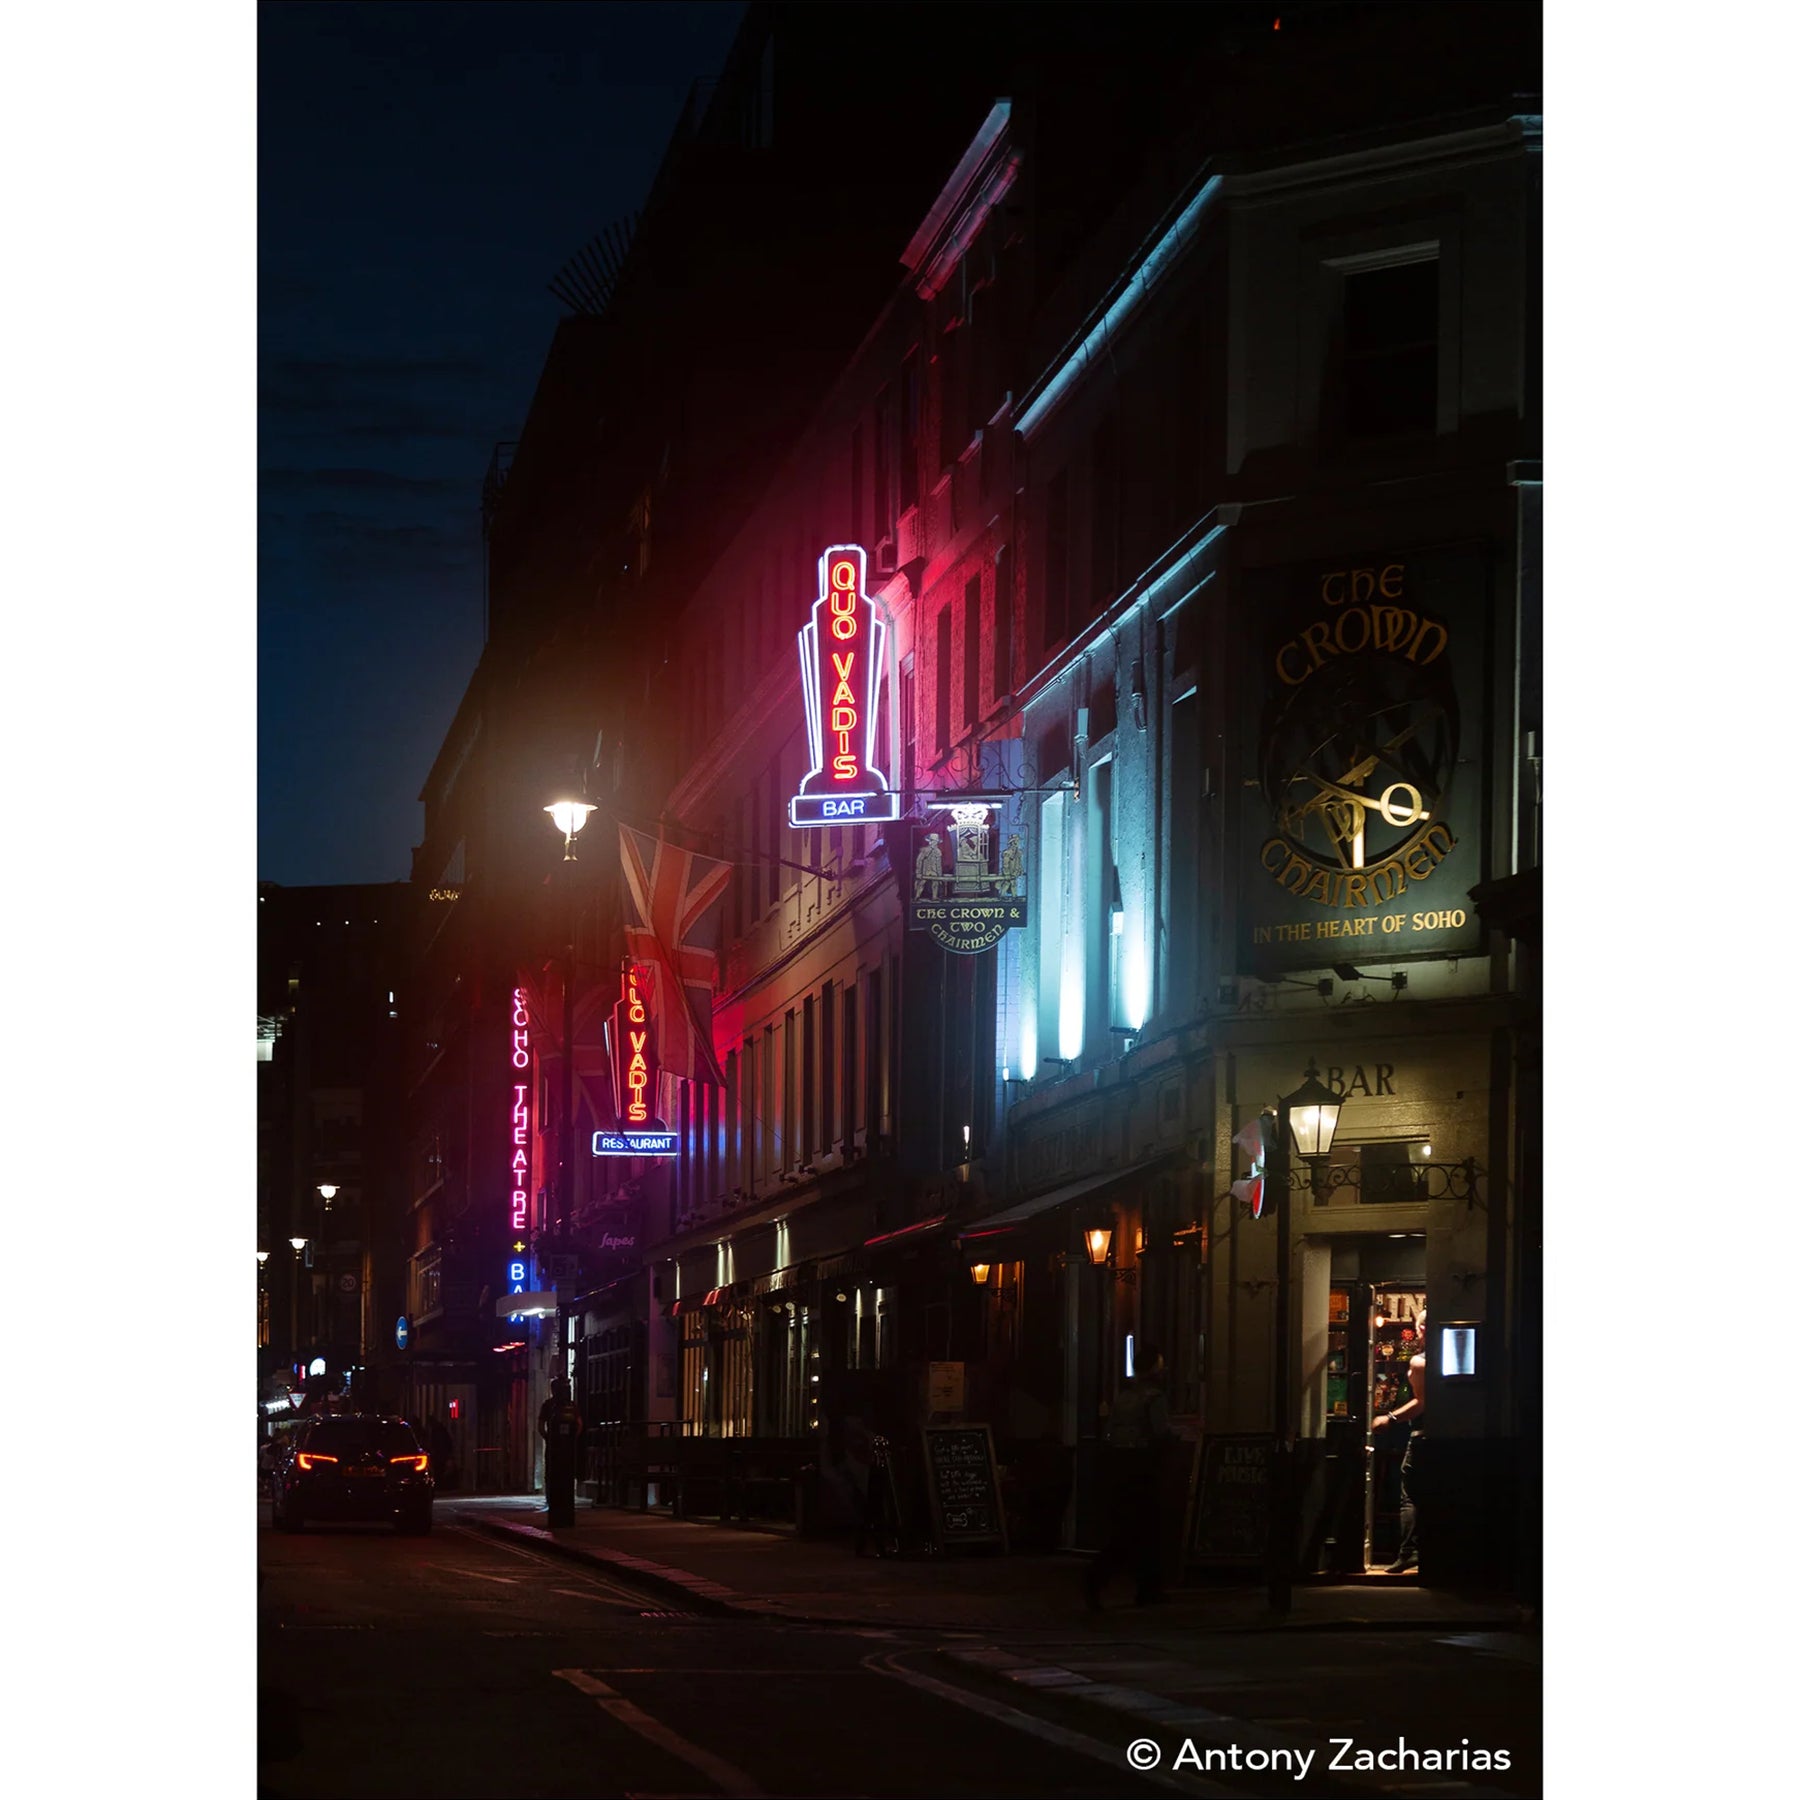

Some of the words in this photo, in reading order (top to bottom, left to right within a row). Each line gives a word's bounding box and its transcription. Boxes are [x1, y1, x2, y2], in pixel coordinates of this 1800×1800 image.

[831, 561, 857, 641] QUO
[1321, 563, 1406, 606] THE
[1275, 603, 1449, 686] CROWN
[832, 652, 857, 779] VADIS
[823, 800, 865, 817] BAR
[1260, 822, 1458, 908] CHAIRMEN
[916, 908, 947, 919] THE
[950, 907, 1005, 919] CROWN
[1009, 907, 1020, 919] &
[949, 921, 986, 933] TWO
[1253, 926, 1272, 944] IN
[1274, 922, 1312, 942] THE
[1316, 914, 1378, 939] HEART
[1381, 913, 1407, 934] OF
[1411, 908, 1467, 932] SOHO
[931, 923, 1005, 949] CHAIRMEN
[512, 987, 529, 1068] SOHO
[629, 1031, 647, 1122] VADIS
[1327, 1063, 1396, 1098] BAR
[512, 1085, 528, 1229] THEATRE
[602, 1137, 672, 1150] RESAURANT
